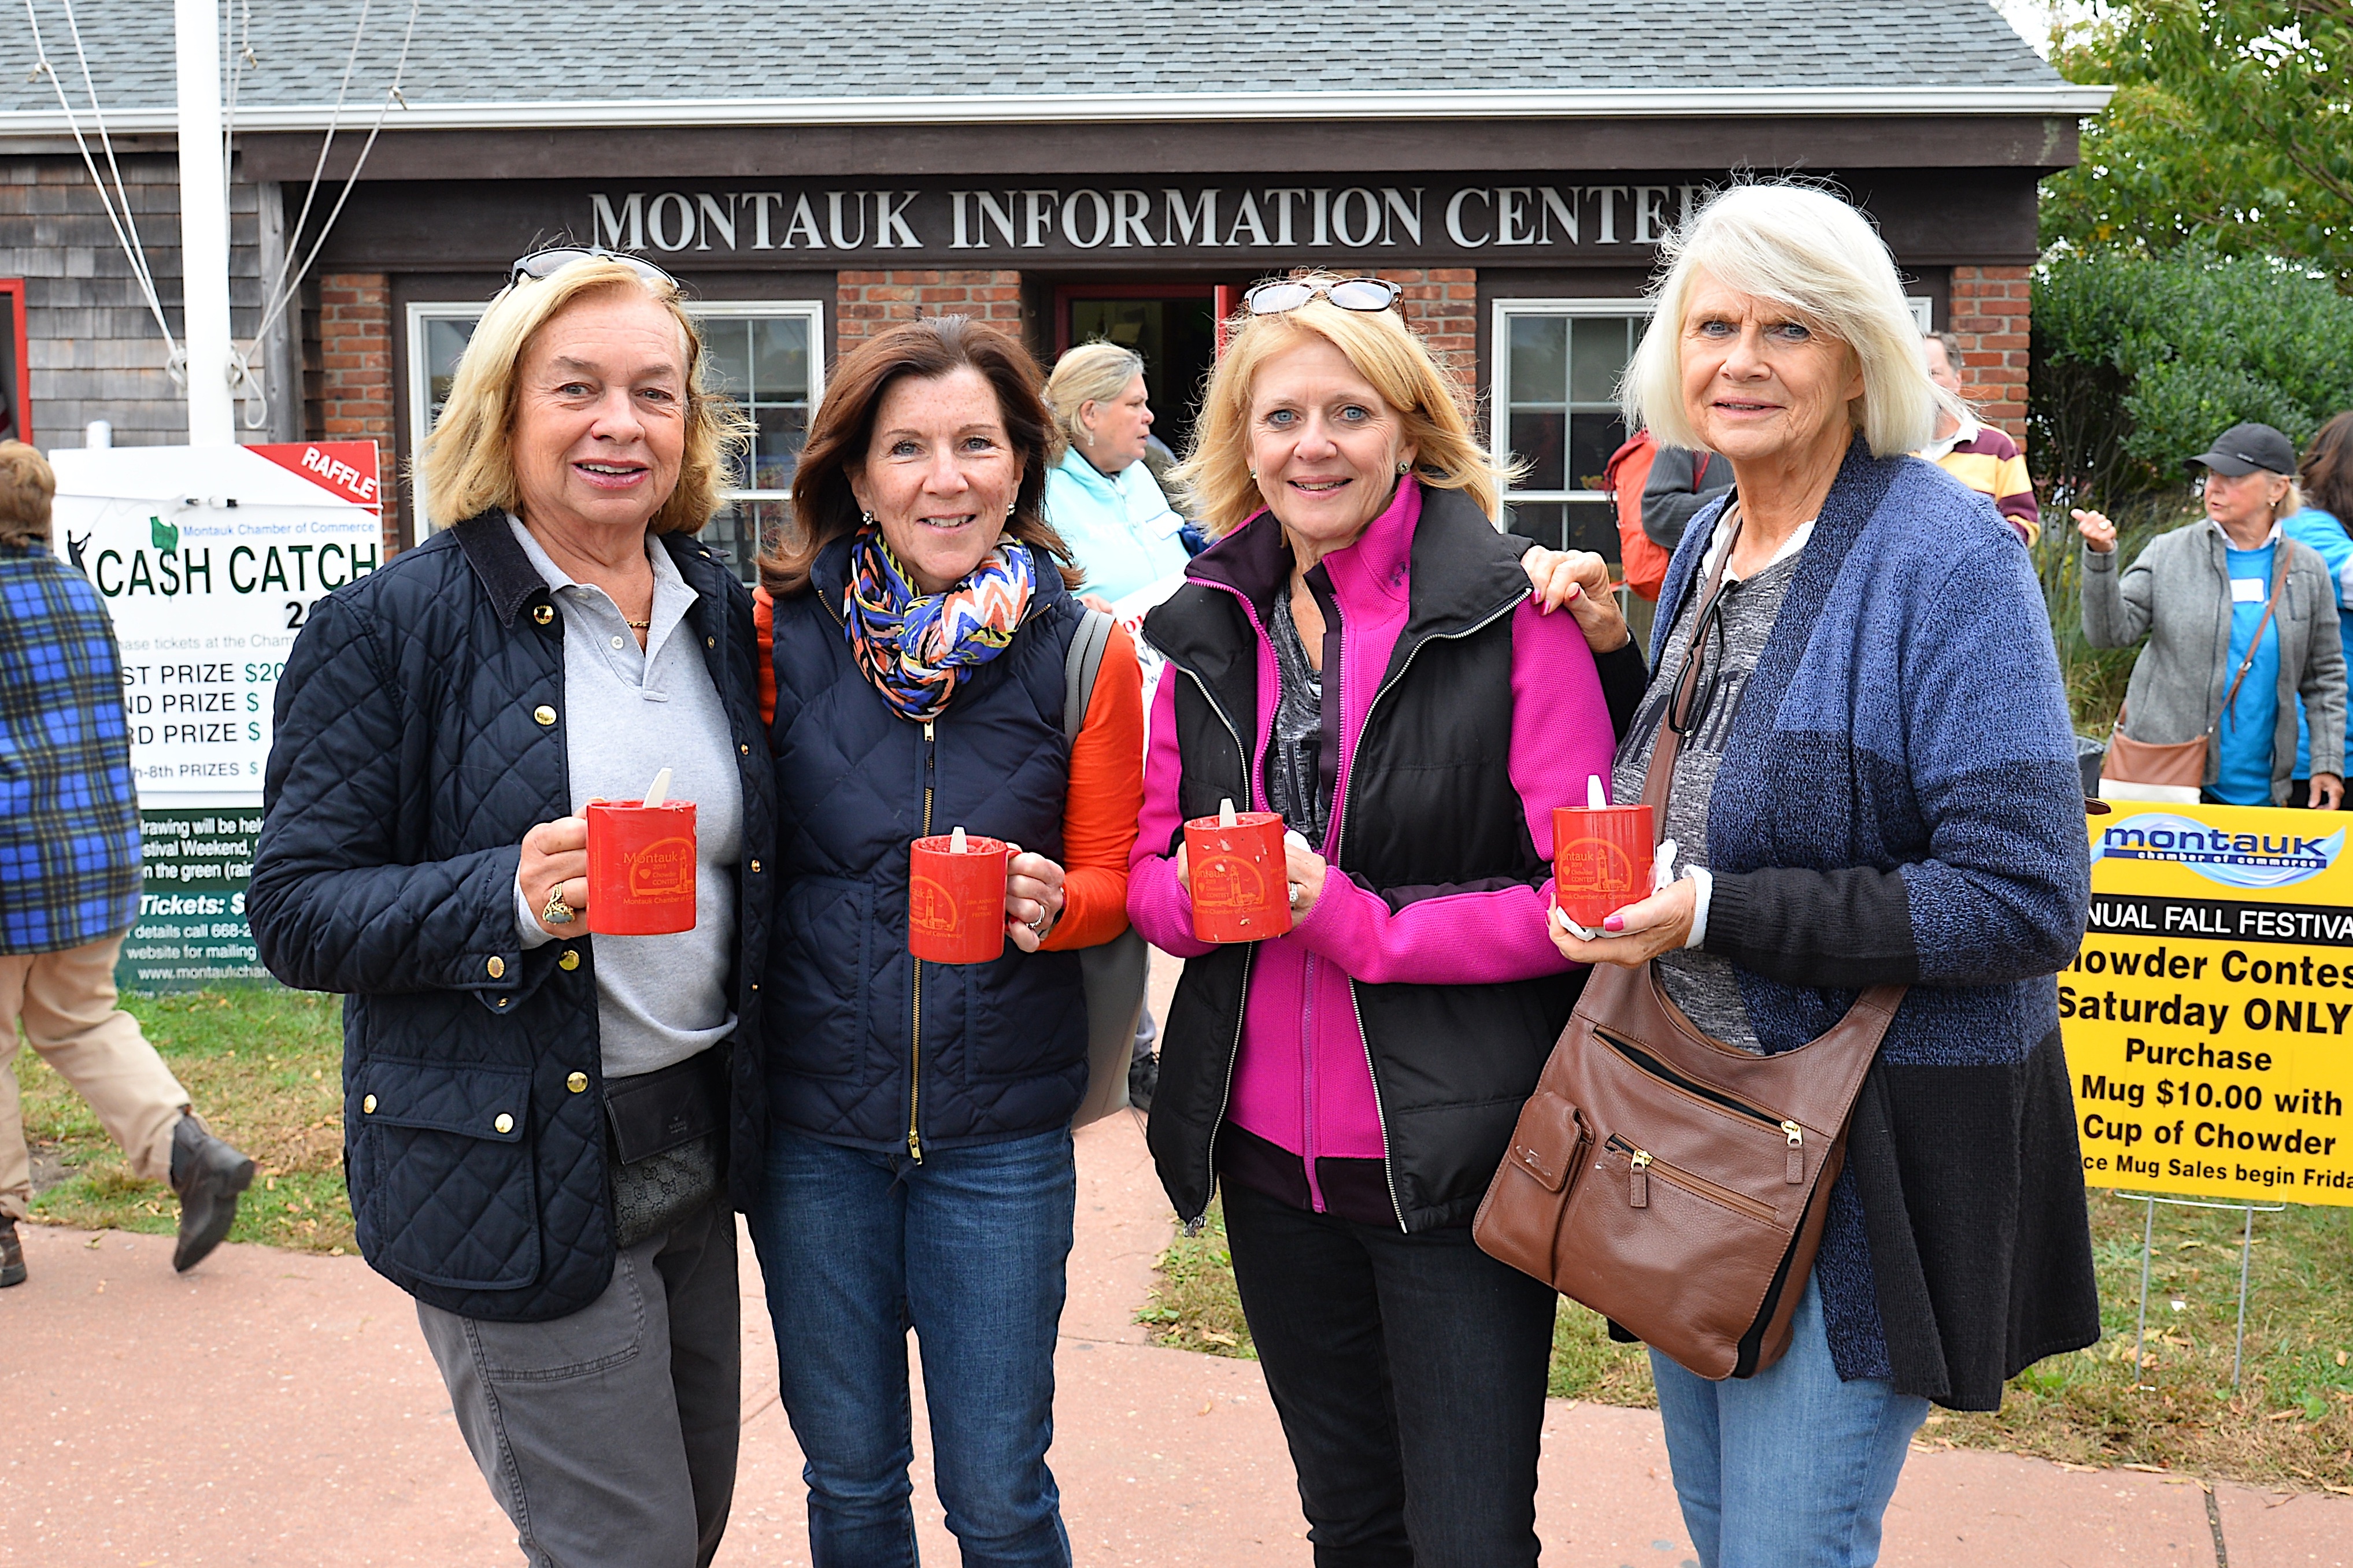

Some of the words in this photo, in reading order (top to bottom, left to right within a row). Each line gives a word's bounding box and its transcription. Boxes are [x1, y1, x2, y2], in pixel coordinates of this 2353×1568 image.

[589, 191, 924, 251] MONTAUK
[949, 187, 1425, 249] INFORMATION
[301, 446, 377, 500] RAFFLE
[183, 524, 234, 537] Montauk
[238, 523, 291, 536] Chamber
[295, 522, 307, 533] of
[311, 522, 375, 534] Commerce
[229, 543, 378, 593] CATCH
[155, 636, 200, 650] tickets
[206, 637, 219, 647] at
[223, 635, 245, 647] the
[251, 634, 297, 647] Cham
[161, 663, 235, 684] PRIZE
[163, 693, 236, 713] PRIZE
[247, 692, 259, 712] $
[164, 724, 237, 743] PRIZE
[248, 722, 260, 742] $
[180, 763, 239, 776] PRIZES
[250, 762, 258, 775] $
[192, 817, 214, 835] will
[217, 817, 237, 834] be
[180, 839, 251, 858] Weekend,
[2104, 828, 2327, 857] montauk
[623, 851, 678, 863] Montauk
[2138, 851, 2205, 862] chamber
[2213, 854, 2229, 864] of
[2237, 856, 2318, 868] commerce
[155, 862, 178, 878] the
[180, 864, 222, 882] green
[139, 894, 225, 916] Tickets:
[654, 896, 679, 904] Chamber
[2165, 906, 2232, 935] FALL
[135, 924, 180, 940] details
[183, 923, 208, 938] call
[211, 924, 253, 937] 668-2
[126, 946, 180, 960] website
[183, 944, 203, 959] for
[205, 944, 257, 961] mailing
[2059, 986, 2229, 1035] Saturday
[2244, 998, 2353, 1035] ONLY
[2126, 1038, 2272, 1071] Purchase
[2082, 1074, 2145, 1107] Mug
[2156, 1078, 2262, 1111] $10.00
[2274, 1089, 2343, 1116] with
[2084, 1114, 2142, 1147] Cup
[2154, 1120, 2184, 1144] of
[2195, 1122, 2336, 1155] Chowder
[2116, 1155, 2159, 1177] Mug
[2169, 1159, 2227, 1180] Sales
[2236, 1163, 2295, 1187] begin
